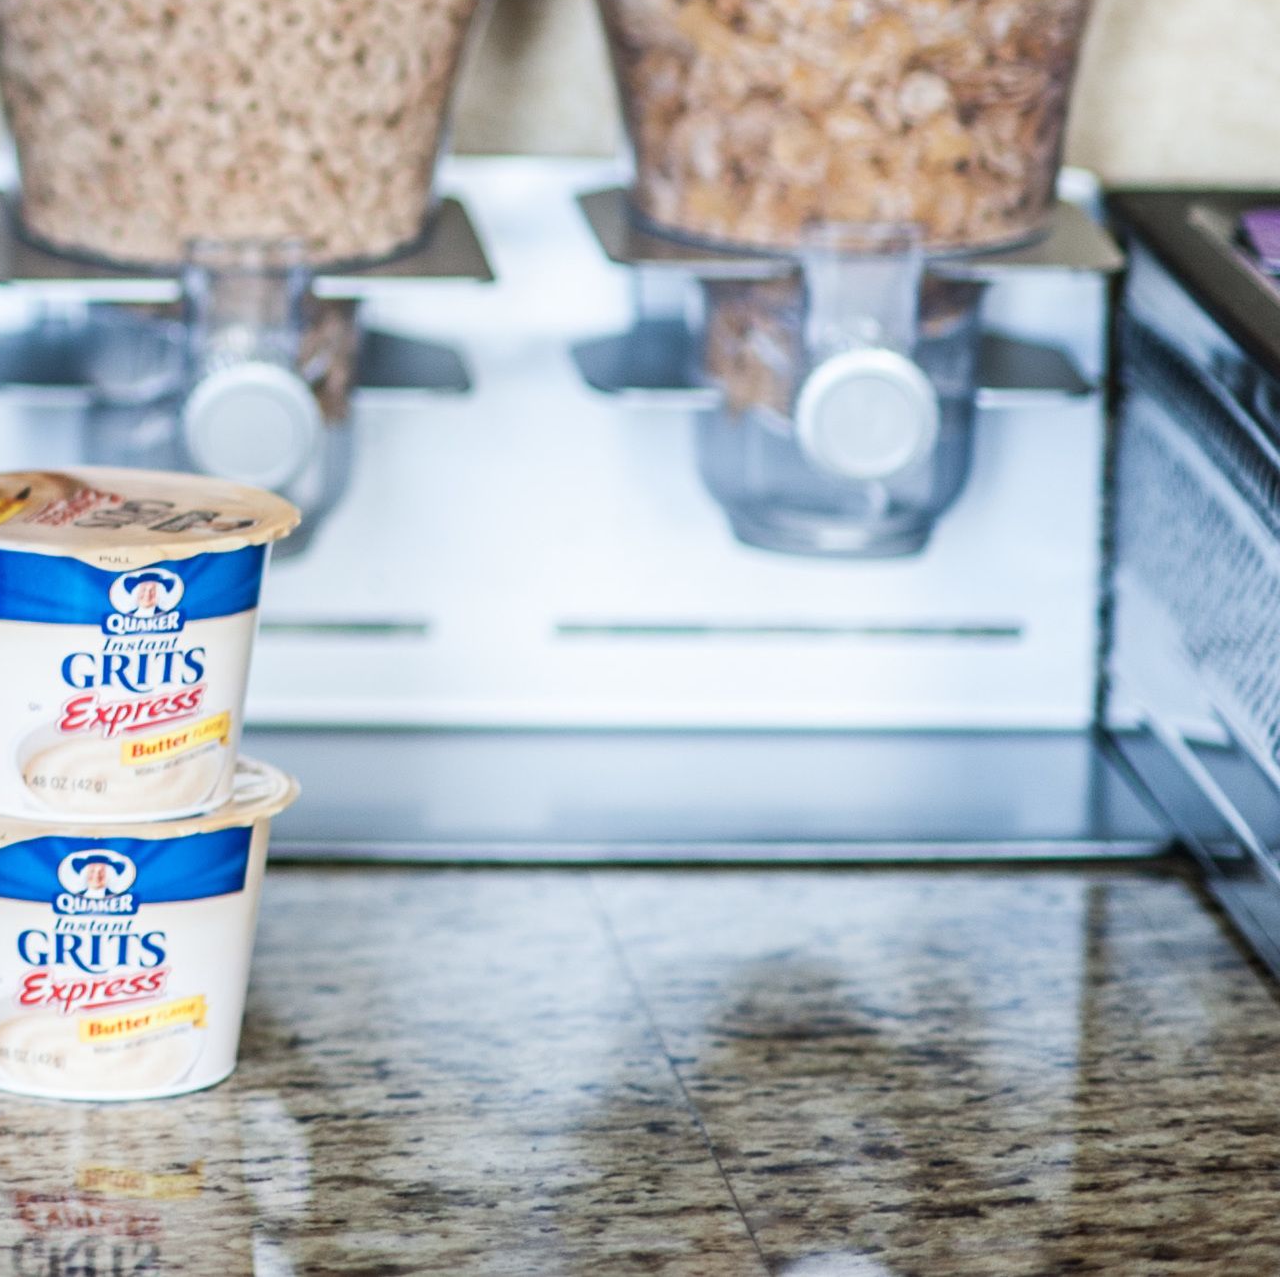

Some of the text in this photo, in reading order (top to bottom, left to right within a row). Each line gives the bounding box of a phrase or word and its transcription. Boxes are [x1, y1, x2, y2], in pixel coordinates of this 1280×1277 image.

[106, 612, 180, 634] QUAKER
[102, 636, 180, 653] Instant
[61, 646, 206, 693] GRITS
[60, 687, 204, 737] Express
[131, 734, 188, 759] Butter
[50, 776, 68, 790] OZ
[55, 893, 133, 914] QUAKER
[54, 917, 133, 933] Instant
[17, 930, 166, 973] GRITS
[19, 968, 166, 1012] Express
[89, 1014, 151, 1038] Butter
